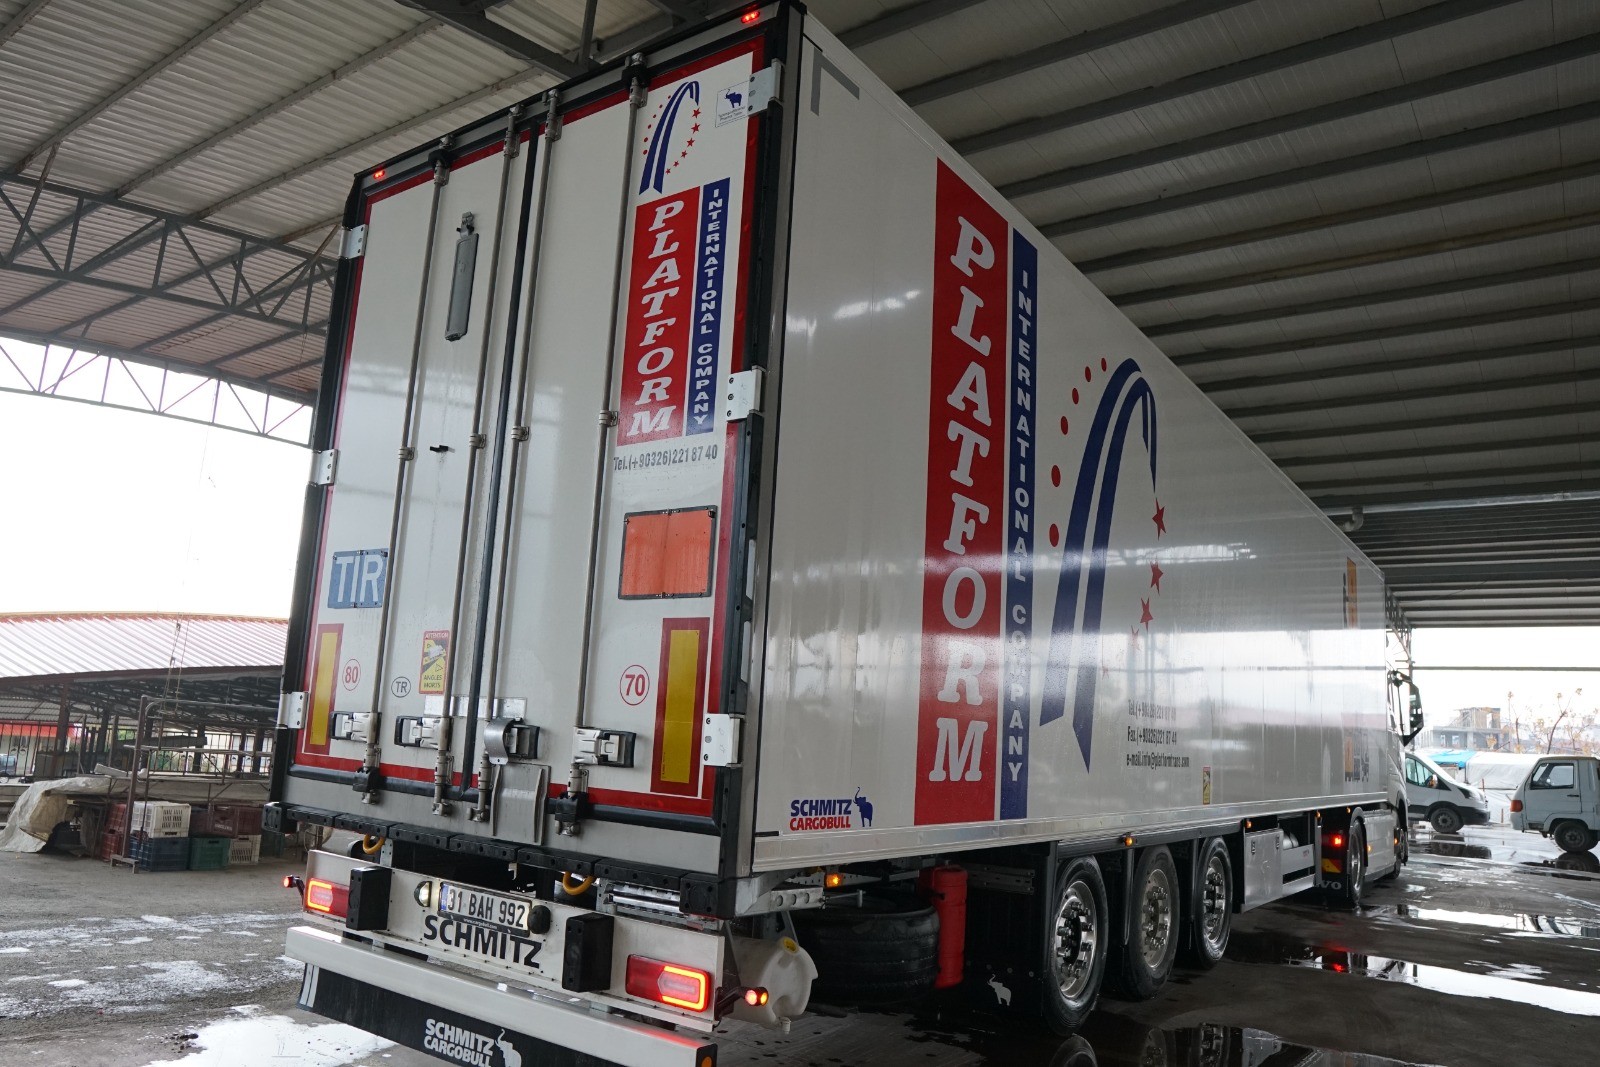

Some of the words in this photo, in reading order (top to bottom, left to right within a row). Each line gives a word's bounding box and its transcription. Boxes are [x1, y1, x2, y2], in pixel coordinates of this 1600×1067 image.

[700, 188, 723, 335] INTERNATIONAL
[626, 200, 684, 437] PLATFORM
[693, 343, 713, 425] COMPANY
[1015, 270, 1032, 582] INTERNATIONAL
[929, 215, 995, 782] PLATFORM
[335, 554, 383, 603] TIR
[345, 666, 359, 683] 80
[395, 681, 408, 693] TR
[625, 674, 646, 696] 70
[1008, 604, 1027, 782] COMPANY
[790, 799, 852, 817] SCHMITZ
[790, 816, 851, 831] CARGOBULL
[448, 888, 463, 913] 31
[468, 893, 494, 920] BAH
[498, 900, 526, 928] 992
[423, 915, 542, 969] SCHMITZ
[423, 1035, 492, 1067] CARGOBULL
[425, 1018, 495, 1056] SCHMITZ
